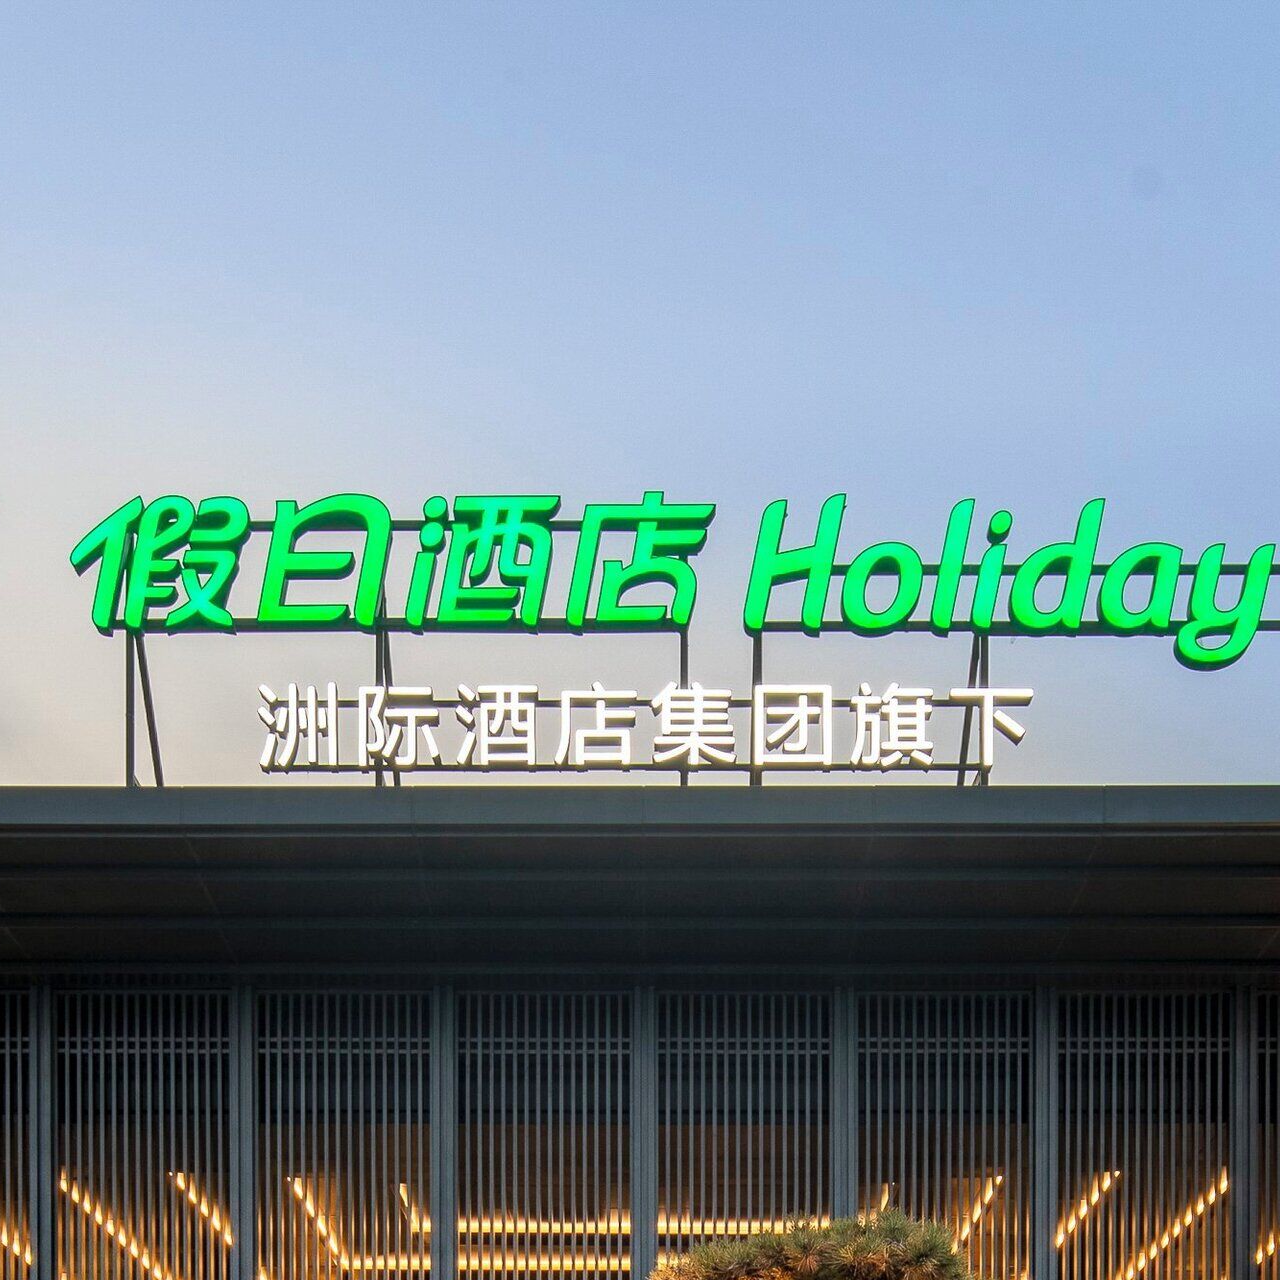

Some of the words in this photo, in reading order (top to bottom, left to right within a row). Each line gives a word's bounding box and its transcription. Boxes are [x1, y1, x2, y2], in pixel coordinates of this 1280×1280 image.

[70, 490, 716, 632] 假日酒店
[743, 494, 1277, 668] Holiday
[257, 682, 1034, 771] 洲际酒店集团旗下
